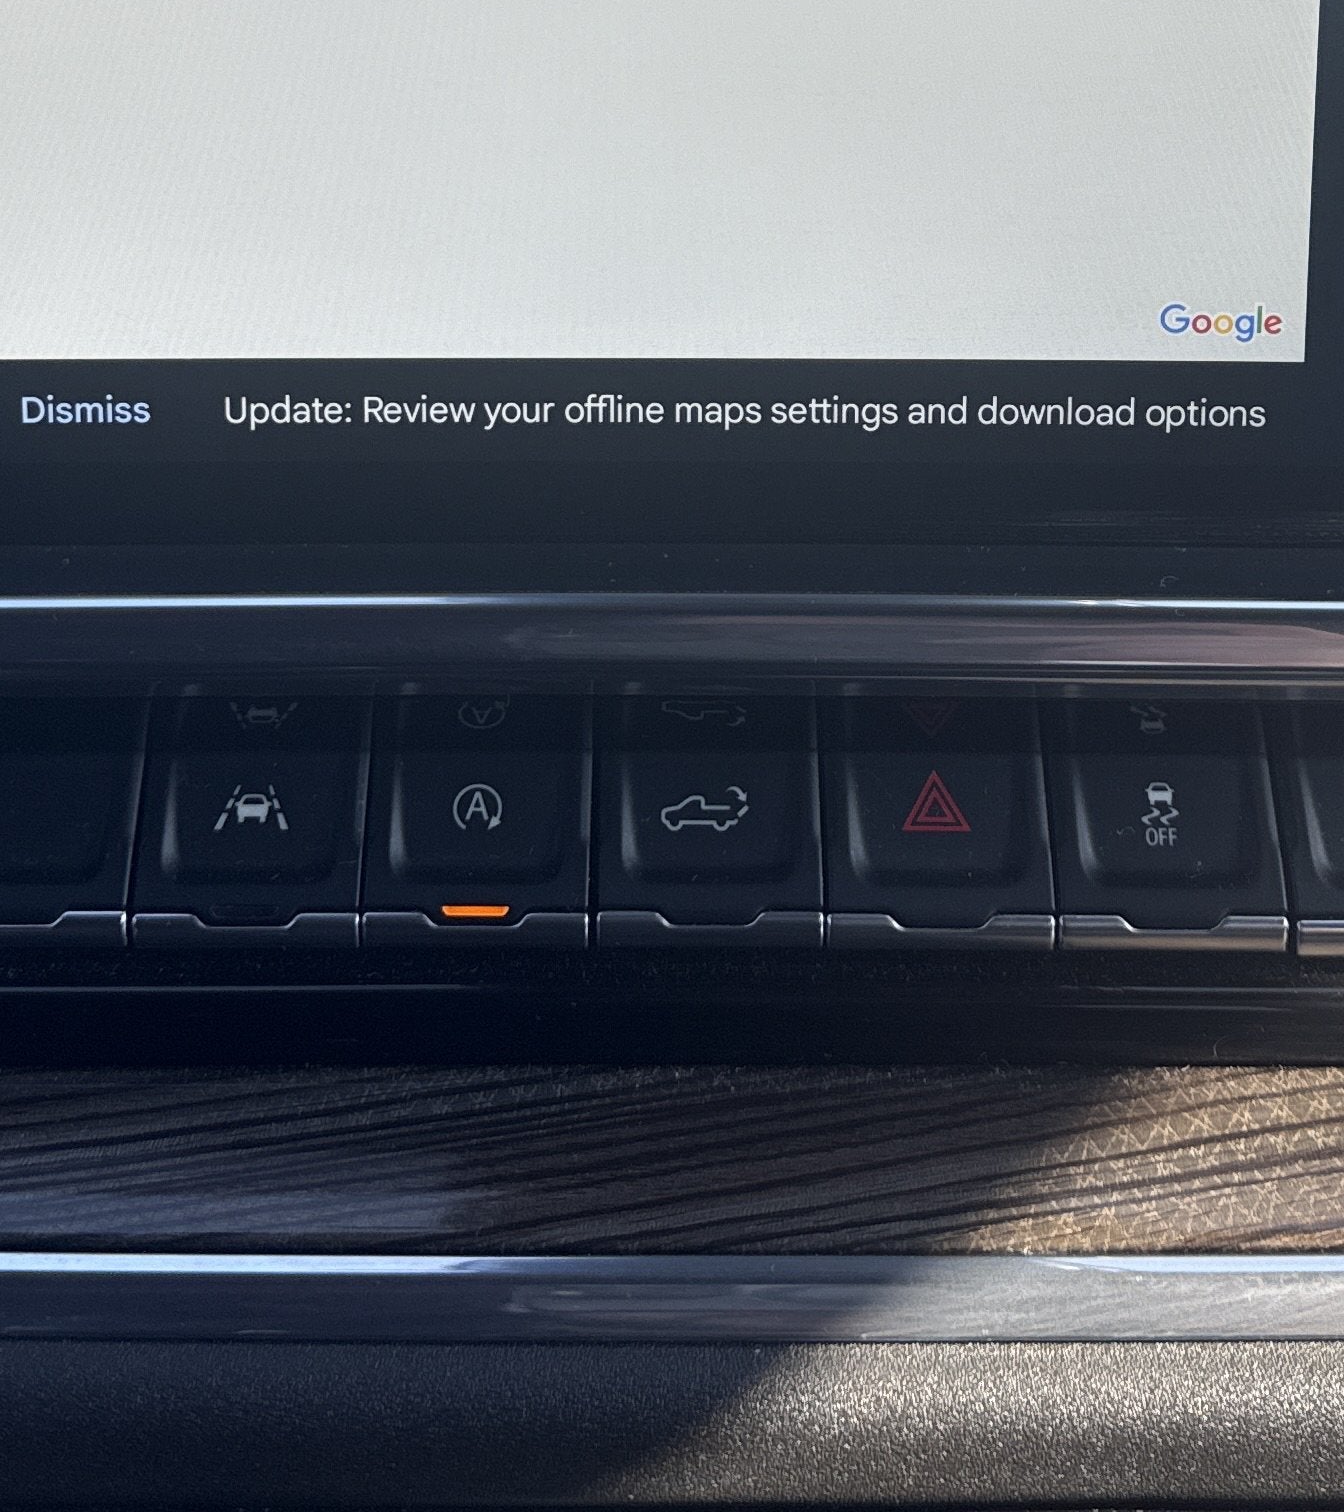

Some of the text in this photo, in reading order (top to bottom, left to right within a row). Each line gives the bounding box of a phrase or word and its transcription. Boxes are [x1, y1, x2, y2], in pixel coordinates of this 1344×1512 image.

[1159, 303, 1282, 342] Google
[21, 393, 151, 424] Dismiss
[224, 393, 1266, 434] Update: Review your offline maps settings and download options
[465, 791, 489, 821] A
[1145, 827, 1177, 846] OFF
